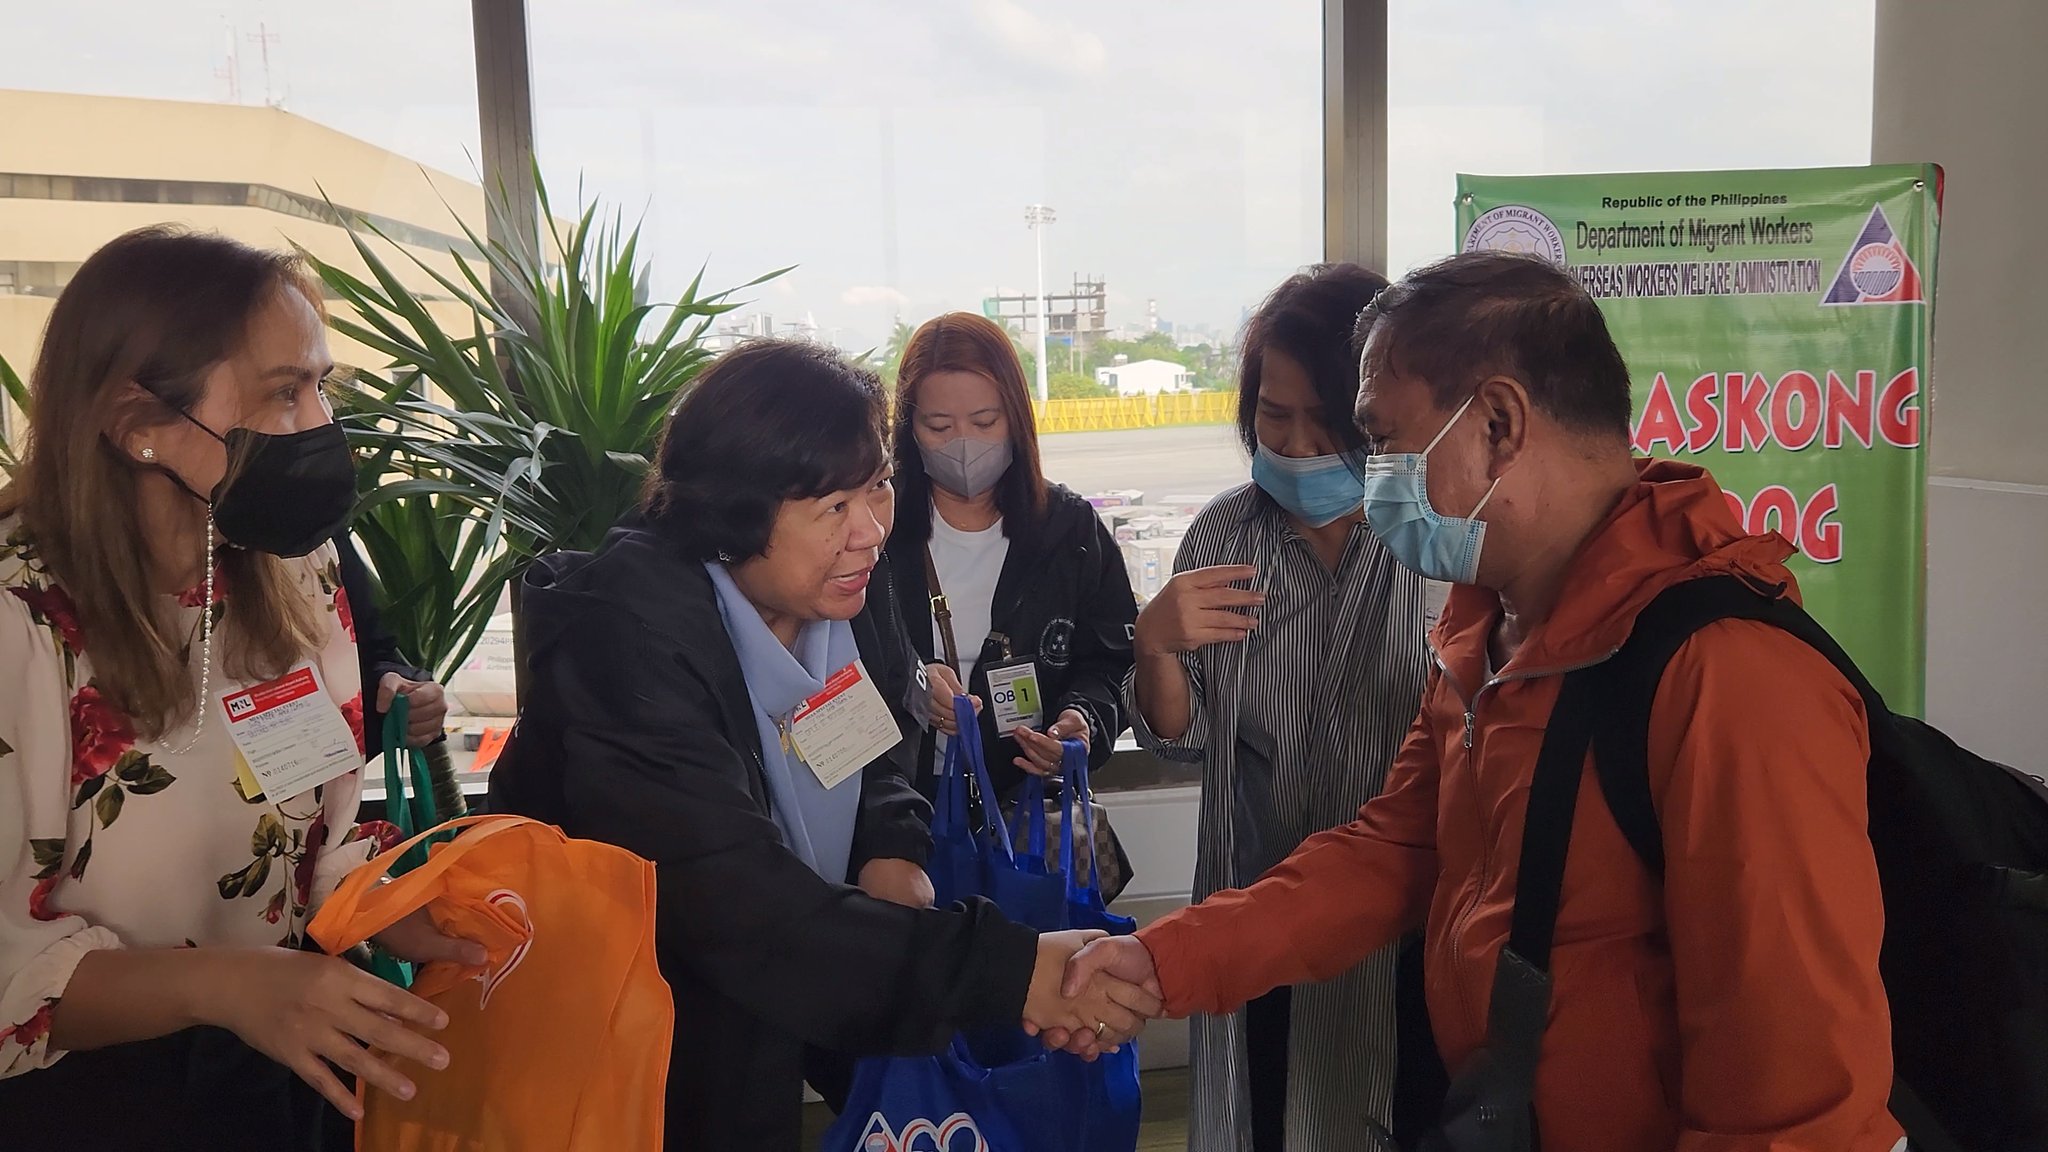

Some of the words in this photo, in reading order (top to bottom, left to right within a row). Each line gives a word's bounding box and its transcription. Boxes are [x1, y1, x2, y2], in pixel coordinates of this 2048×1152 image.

[1602, 195, 1663, 211] Republic
[1667, 195, 1681, 207] of
[1685, 194, 1706, 206] the
[1711, 193, 1788, 208] Philippines
[1493, 211, 1505, 221] OF
[1506, 209, 1544, 227] MIGRANT
[1576, 220, 1665, 256] Department
[1669, 218, 1685, 247] of
[1689, 217, 1746, 253] Migrant
[1750, 216, 1814, 245] Workers
[1626, 262, 1678, 297] WORKERS
[1681, 260, 1731, 295] WELFARE
[1733, 259, 1822, 294] ADMINISTRATION
[1628, 367, 1920, 455] ASKONG
[994, 689, 1016, 704] OB
[1020, 687, 1029, 702] 1
[230, 698, 251, 712] MNL
